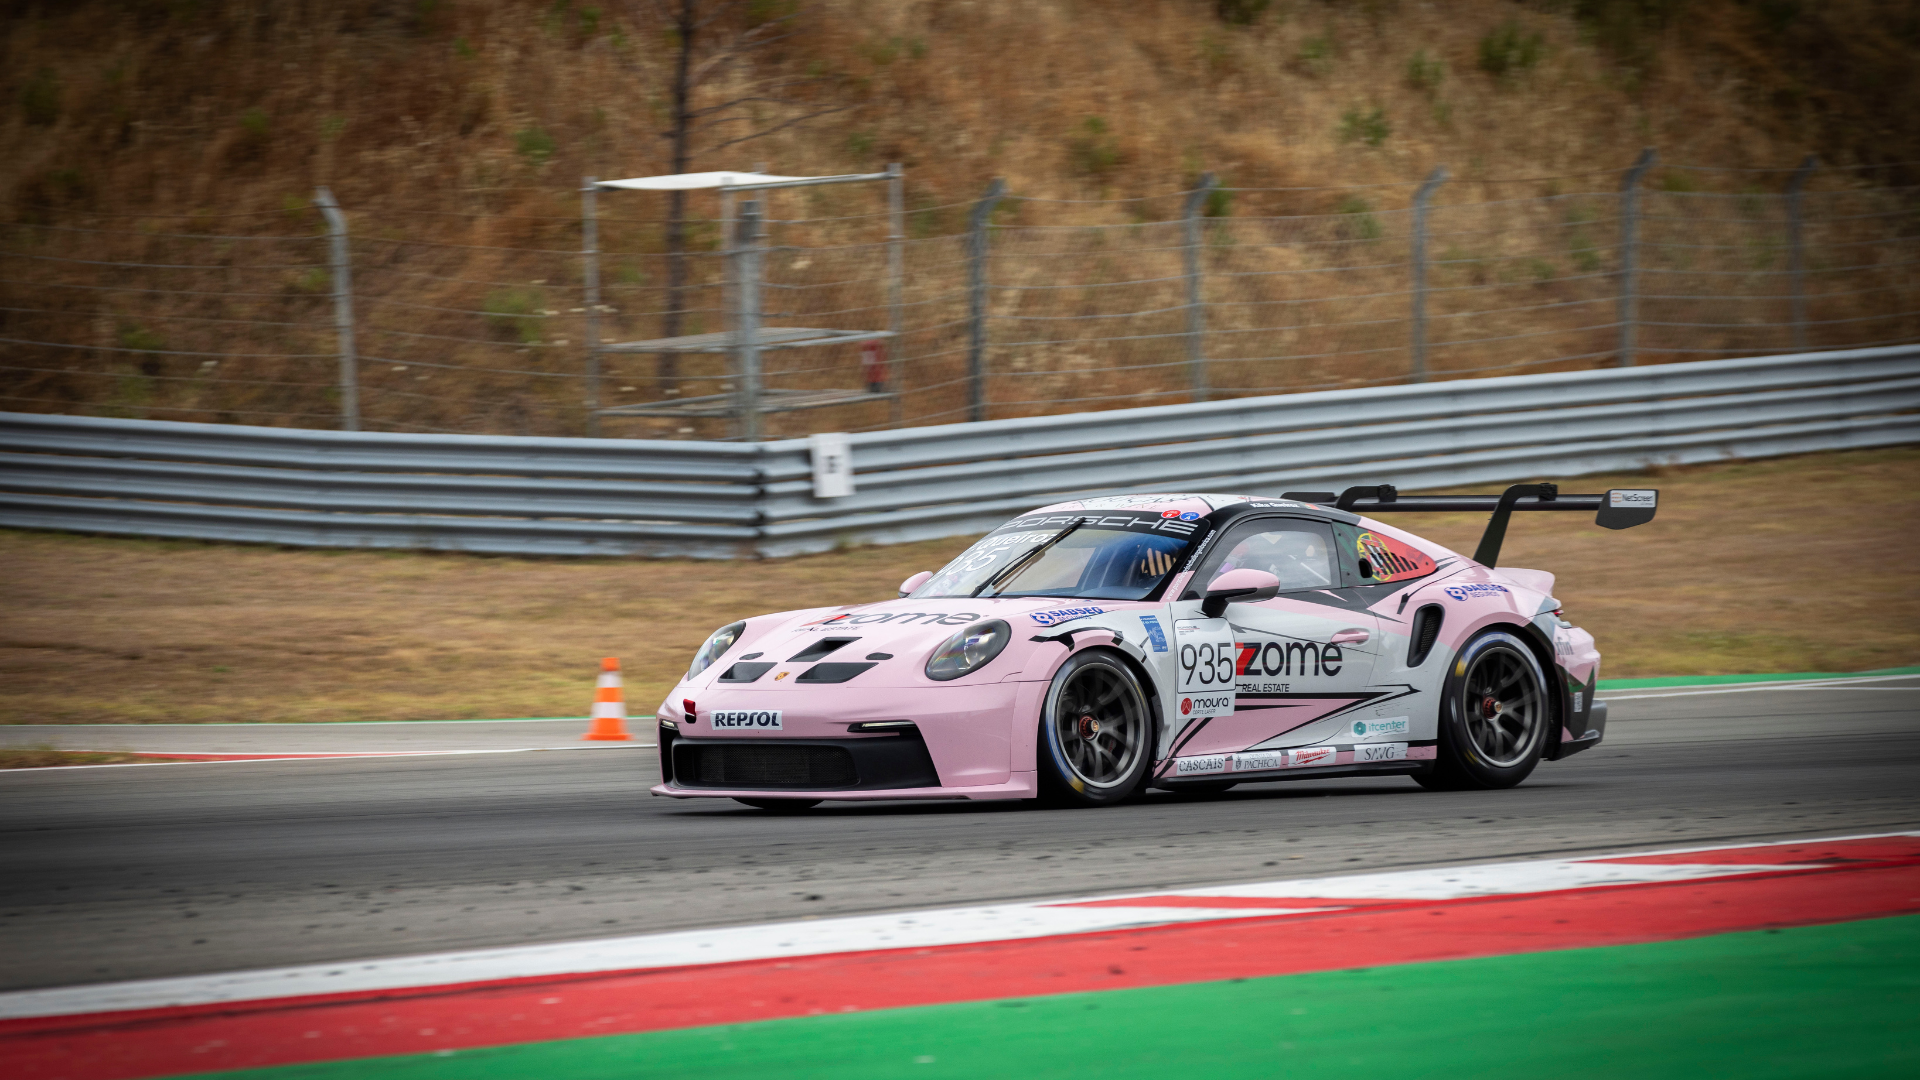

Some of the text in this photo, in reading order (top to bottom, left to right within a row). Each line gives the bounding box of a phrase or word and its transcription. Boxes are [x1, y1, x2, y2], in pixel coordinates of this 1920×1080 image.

[997, 515, 1199, 536] PORSCHE
[1180, 642, 1233, 685] 935
[1242, 683, 1290, 692] REAL ESTATE
[1193, 697, 1229, 709] moura
[715, 711, 780, 727] REPSOL
[1368, 720, 1406, 732] itcenter
[1296, 748, 1331, 761] Milwaukee
[1179, 758, 1224, 772] CASCAIS
[1244, 759, 1278, 769] PACHECA
